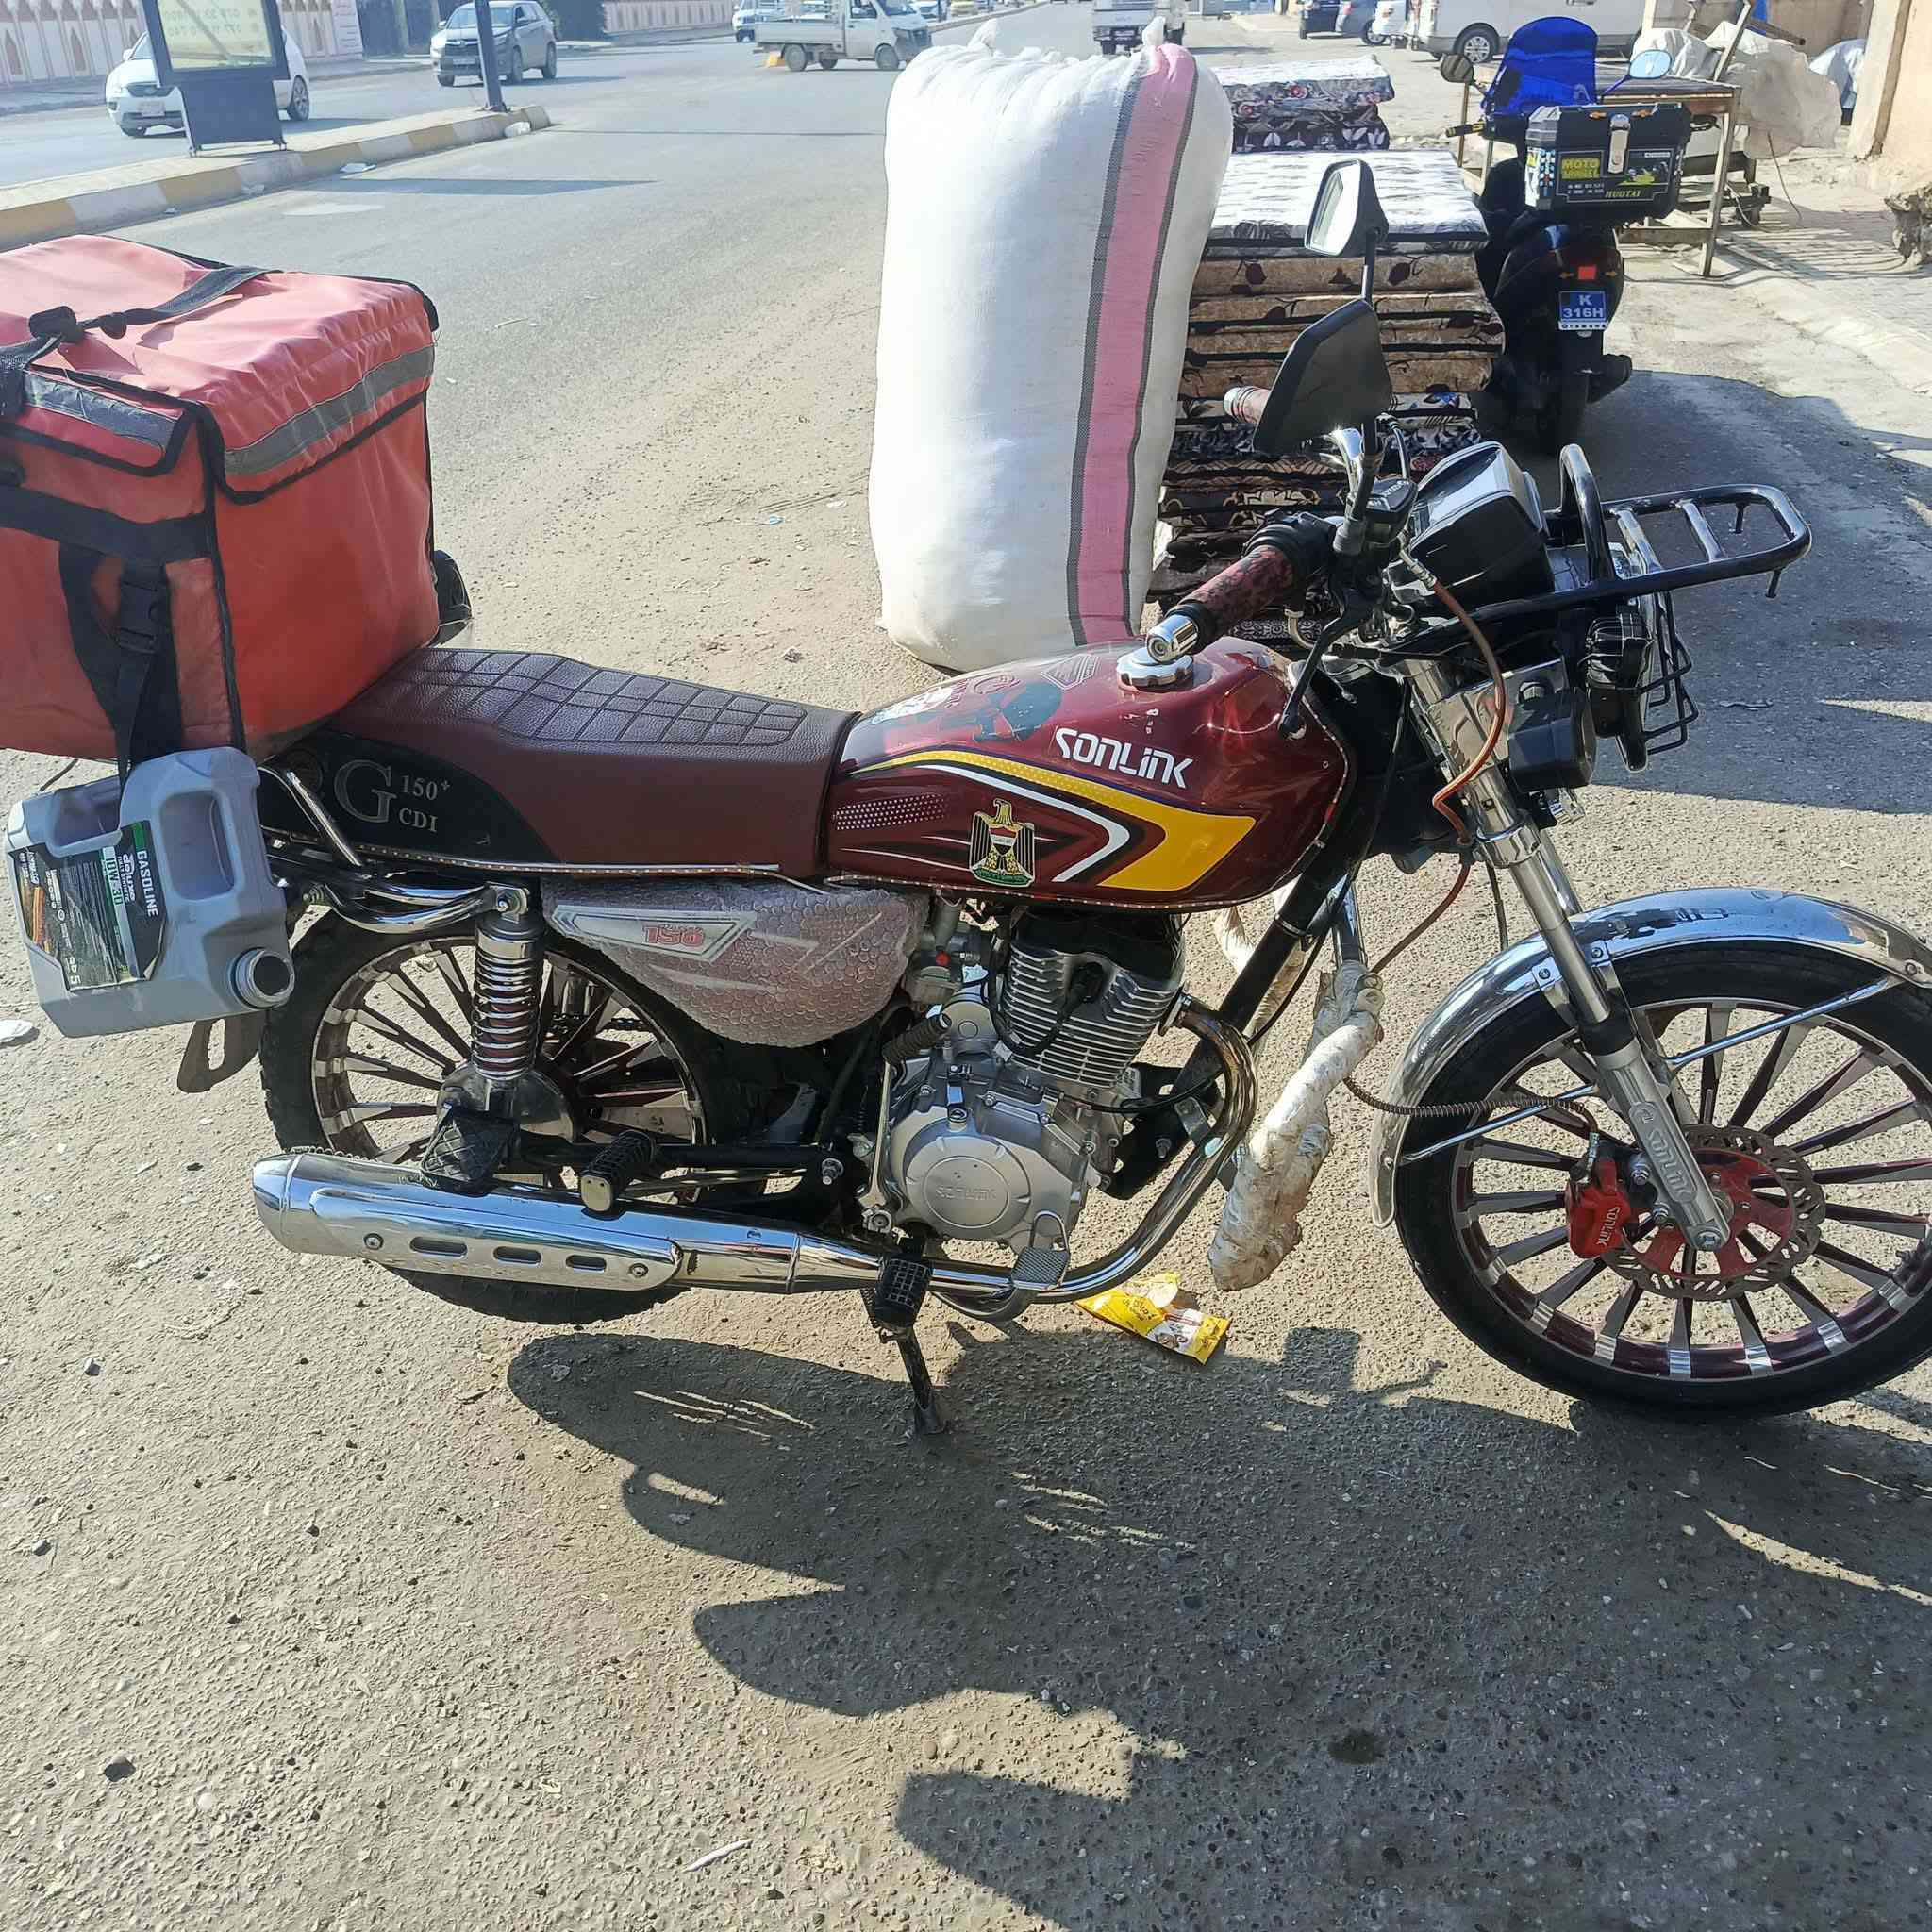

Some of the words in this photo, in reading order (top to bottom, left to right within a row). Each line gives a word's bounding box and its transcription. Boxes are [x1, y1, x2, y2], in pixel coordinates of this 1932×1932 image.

[1562, 308, 1604, 318] 316H
[1578, 294, 1593, 307] K
[1055, 727, 1193, 789] SONLINK
[333, 758, 397, 823] G
[399, 808, 439, 833] CDI
[137, 851, 158, 917] GASOLINE
[1596, 1207, 1621, 1247] SONLINK
